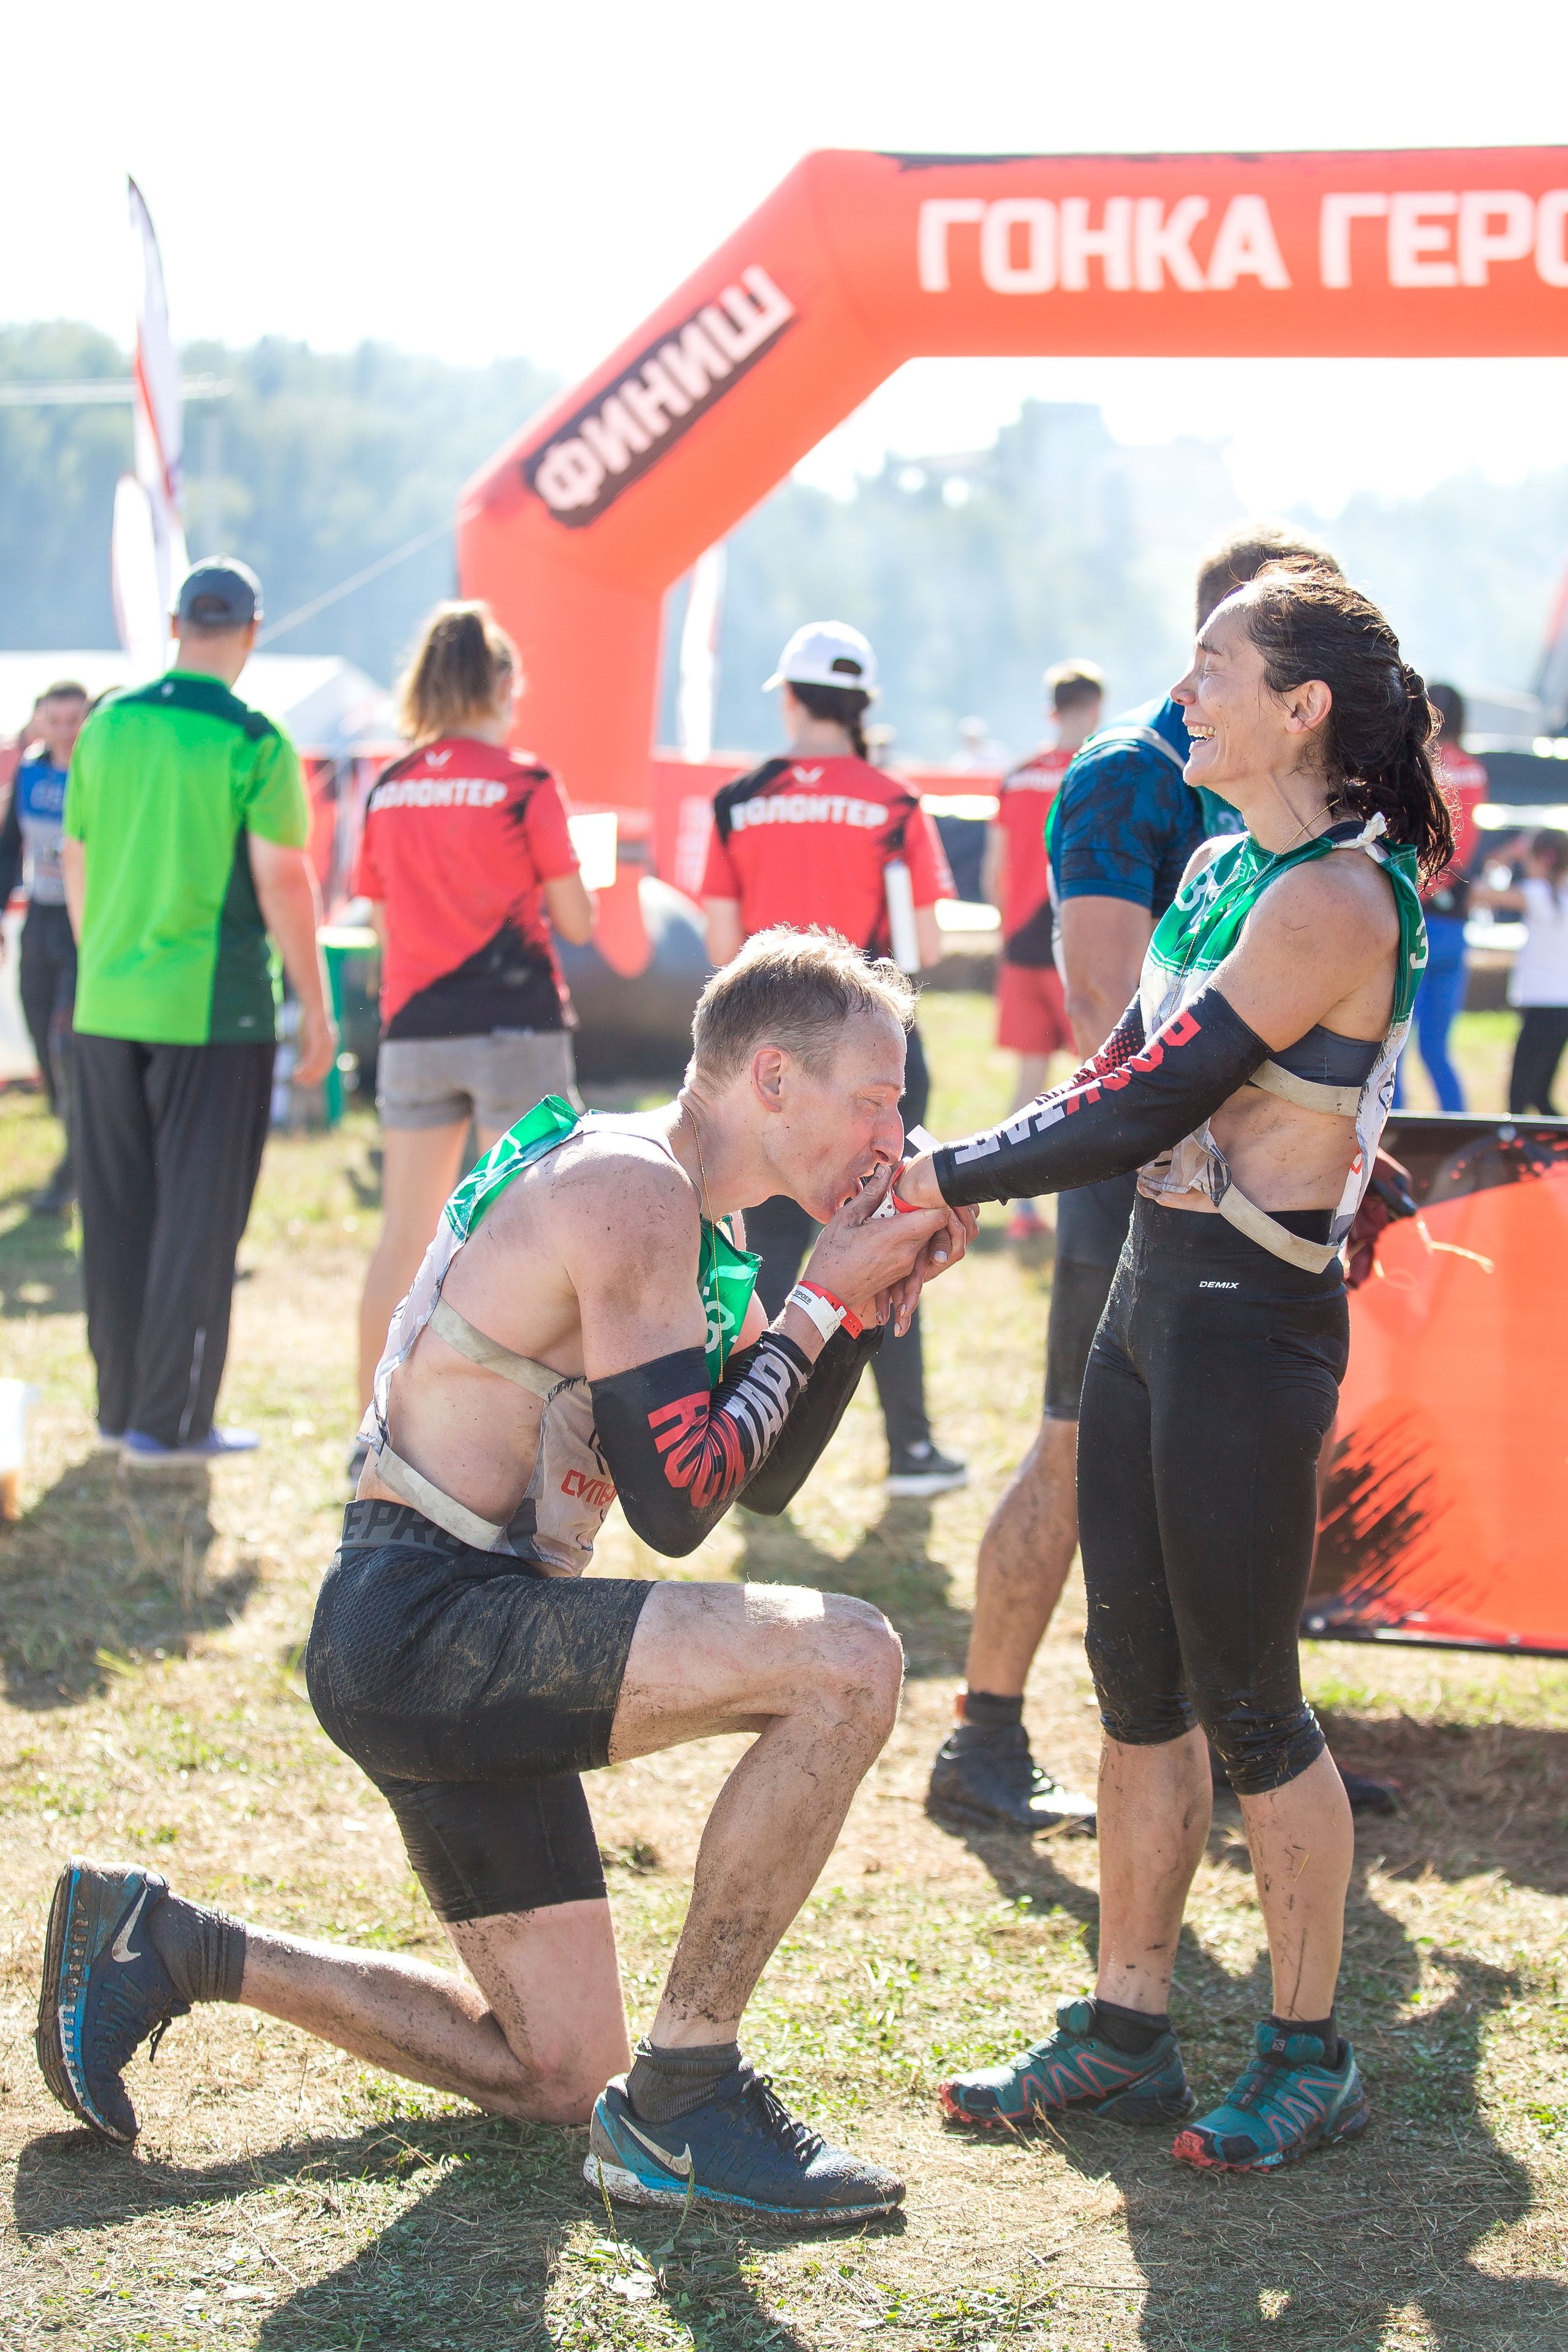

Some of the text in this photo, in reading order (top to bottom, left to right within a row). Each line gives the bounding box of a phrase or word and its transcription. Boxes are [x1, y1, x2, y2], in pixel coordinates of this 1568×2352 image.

[919, 194, 1292, 295] ГОНКА
[534, 262, 797, 512] ФИНИШ
[1199, 1281, 1240, 1289] DEMIX
[647, 1341, 808, 1509] ROCKTAP
